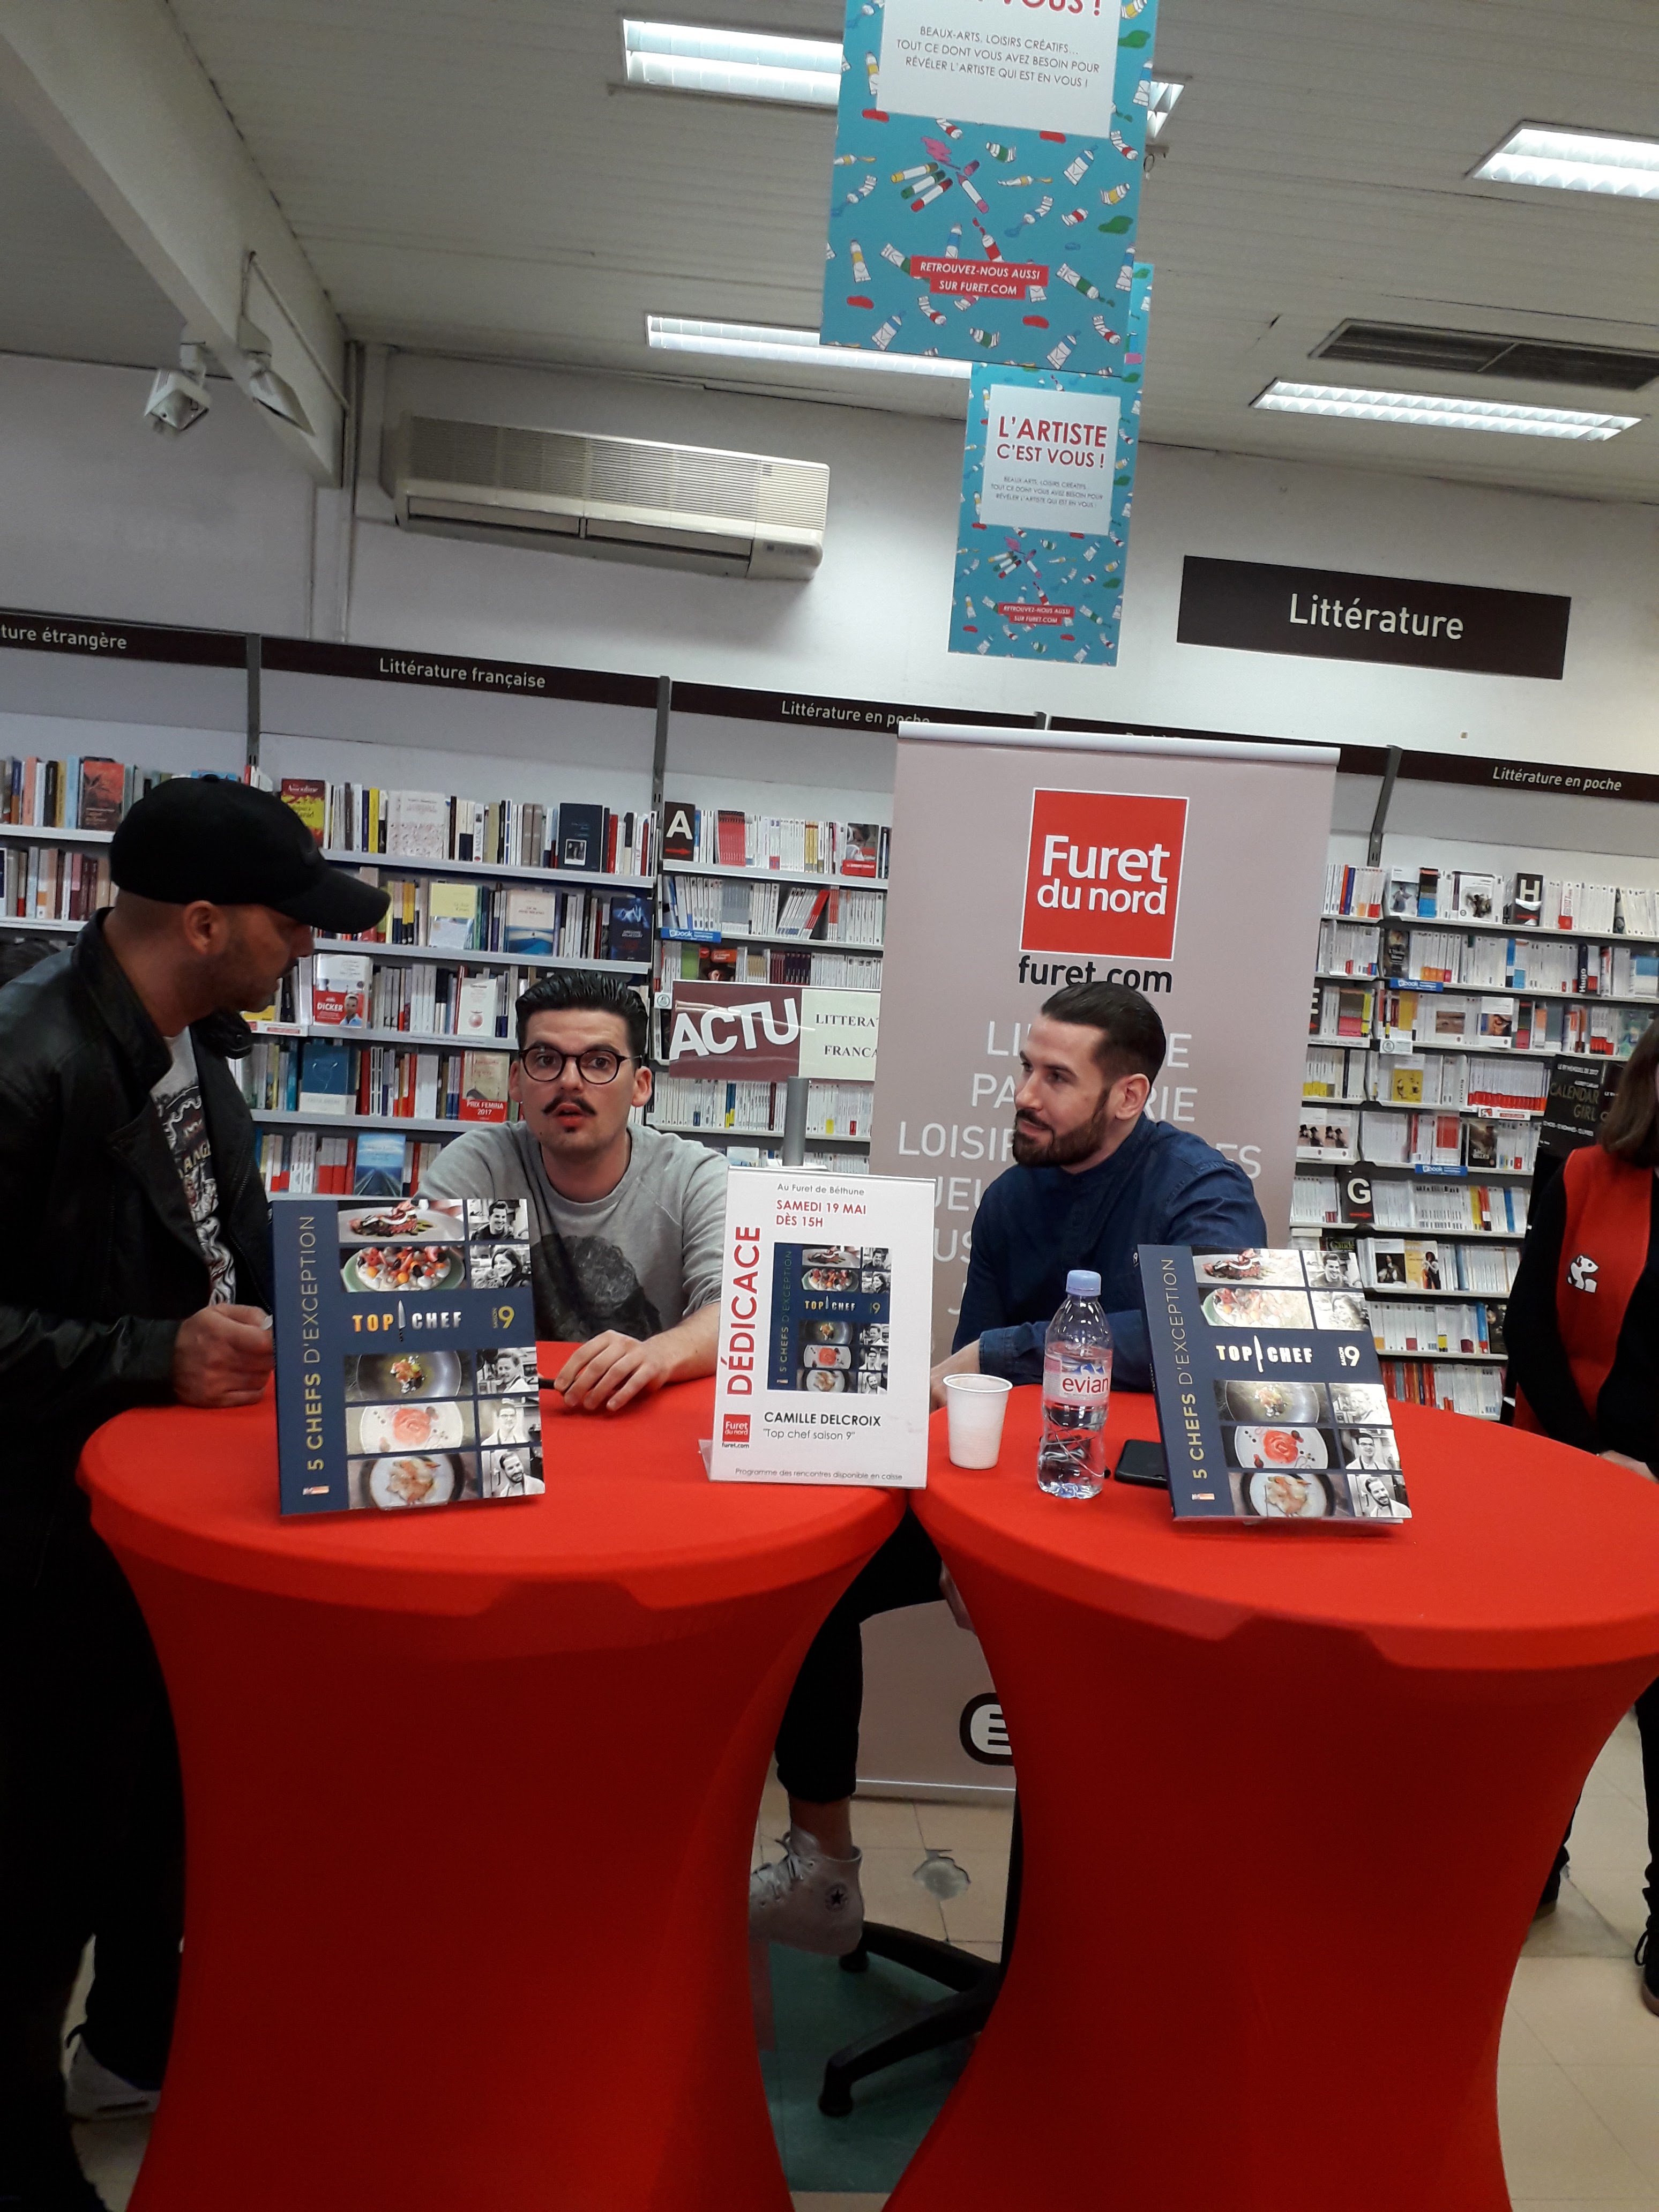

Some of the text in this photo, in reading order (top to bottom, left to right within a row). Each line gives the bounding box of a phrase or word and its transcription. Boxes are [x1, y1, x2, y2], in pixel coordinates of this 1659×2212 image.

[986, 35, 1022, 47] LOISIRS
[896, 39, 1100, 73] TOUT CE DONT VOUS AVEZ BESOIN POUR
[905, 56, 947, 70] RÉVÉLER
[951, 63, 995, 76] L'ARTISTE
[998, 68, 1017, 79] QUI
[1020, 71, 1035, 81] EST
[1037, 73, 1050, 83] EN
[1054, 76, 1082, 87] VOUS
[920, 261, 1040, 280] RETROUVEZ-NOUS AUSSI
[939, 280, 1017, 295] SUR FURET.COM
[999, 416, 1108, 448] L'ARTISTE
[997, 443, 1104, 468] C'EST VOUS !
[1289, 593, 1464, 641] Littérature
[1, 624, 128, 651] ture étrangère
[379, 657, 545, 689] Littérature française
[781, 700, 861, 722] Littérature
[865, 712, 883, 724] en
[1492, 766, 1622, 791] Littérature en poche
[666, 810, 693, 840] A
[1042, 834, 1170, 884] Furet
[1037, 878, 1167, 915] du nord
[1019, 955, 1172, 992] furetcom
[317, 1002, 343, 1012] DICKER
[669, 998, 800, 1060] ACTU
[816, 1014, 879, 1027] LITTERA
[1549, 1082, 1599, 1104] CALENDAR
[467, 1100, 504, 1110] PRIX FEMINA
[1574, 1104, 1596, 1122] GIRL
[792, 1184, 813, 1192] Furet
[829, 1186, 865, 1196] Béthune
[1347, 1178, 1371, 1204] G
[776, 1199, 866, 1215] SAMEDI 19 MAI
[776, 1212, 823, 1227] DÈS 15H
[299, 1216, 322, 1364] D'EXCEPTION
[498, 1305, 515, 1329] 9
[721, 1226, 760, 1395] DÉDICACE
[804, 1300, 856, 1312] TOP CHEF
[872, 1302, 881, 1314] 9
[352, 1311, 463, 1333] TOP CHEF
[1161, 1258, 1194, 1386] D'EXCEPTION
[779, 1327, 789, 1363] CHEFS
[1216, 1344, 1313, 1364] TOP CHEF
[1344, 1346, 1360, 1367] 9
[1062, 1376, 1109, 1393] evian
[303, 1374, 325, 1449] CHEFS
[764, 1412, 881, 1426] CAMILLE DELCROIX
[726, 1421, 749, 1430] Furet
[787, 1429, 811, 1439] chef
[813, 1430, 843, 1440] saison
[1181, 1393, 1205, 1461] CHEFS
[307, 1459, 325, 1471] 5
[735, 1468, 777, 1476] Programme
[833, 1471, 869, 1479] disponible
[1192, 1468, 1208, 1479] 5
